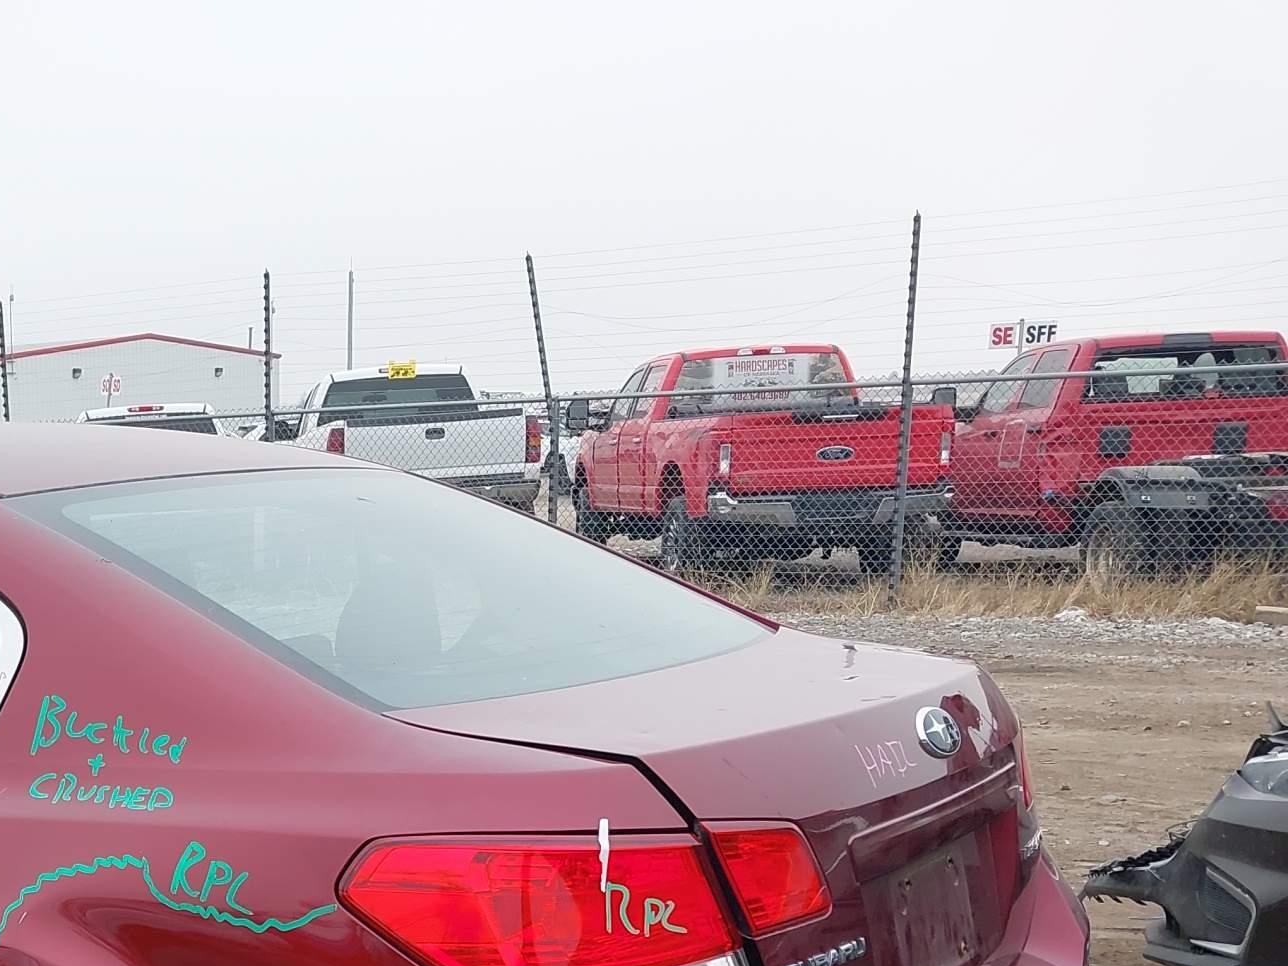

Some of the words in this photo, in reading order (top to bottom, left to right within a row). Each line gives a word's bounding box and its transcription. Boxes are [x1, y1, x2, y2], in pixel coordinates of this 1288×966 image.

[991, 326, 1014, 346] SE
[1025, 324, 1058, 344] SFF
[734, 358, 788, 373] HARDSCAPES
[853, 740, 919, 790] HAIL
[28, 772, 175, 812] CRUSHED
